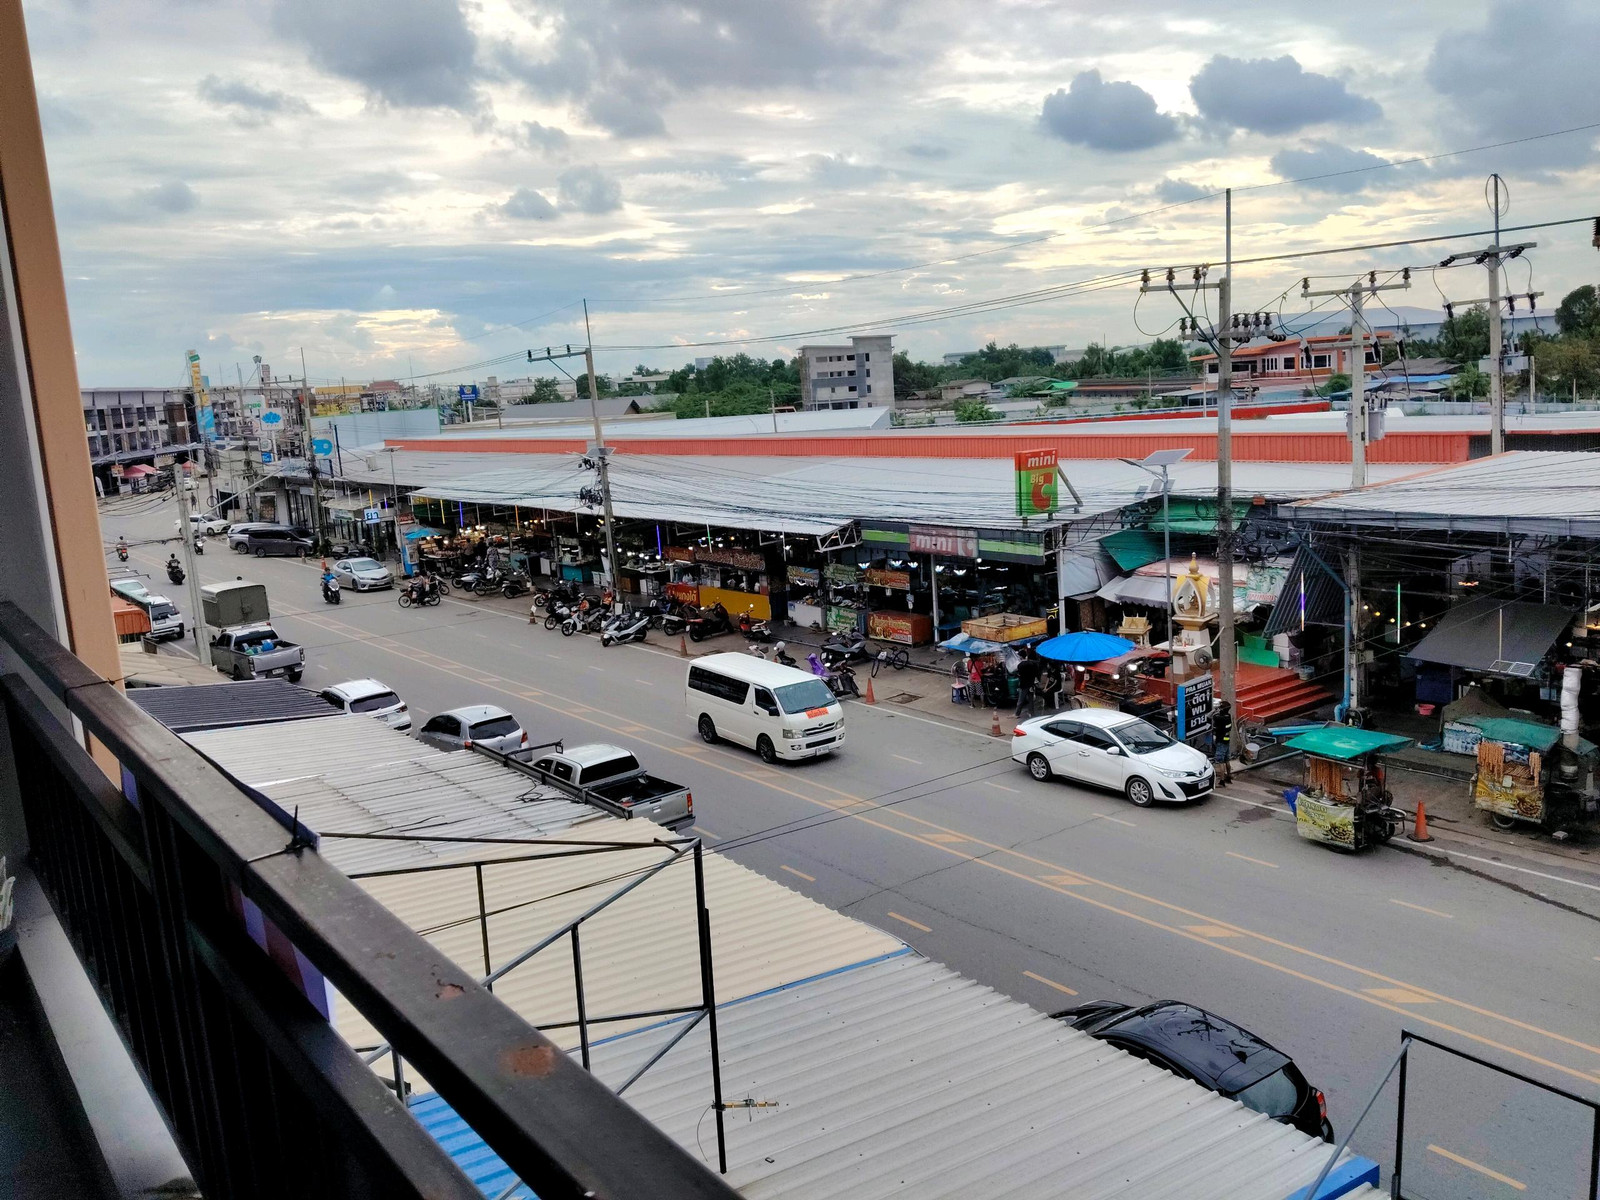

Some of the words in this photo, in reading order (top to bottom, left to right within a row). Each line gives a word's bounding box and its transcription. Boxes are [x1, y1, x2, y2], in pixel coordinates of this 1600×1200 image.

[1027, 450, 1056, 468] mini
[1030, 474, 1044, 485] Big
[1031, 472, 1054, 510] C
[915, 529, 952, 552] mini
